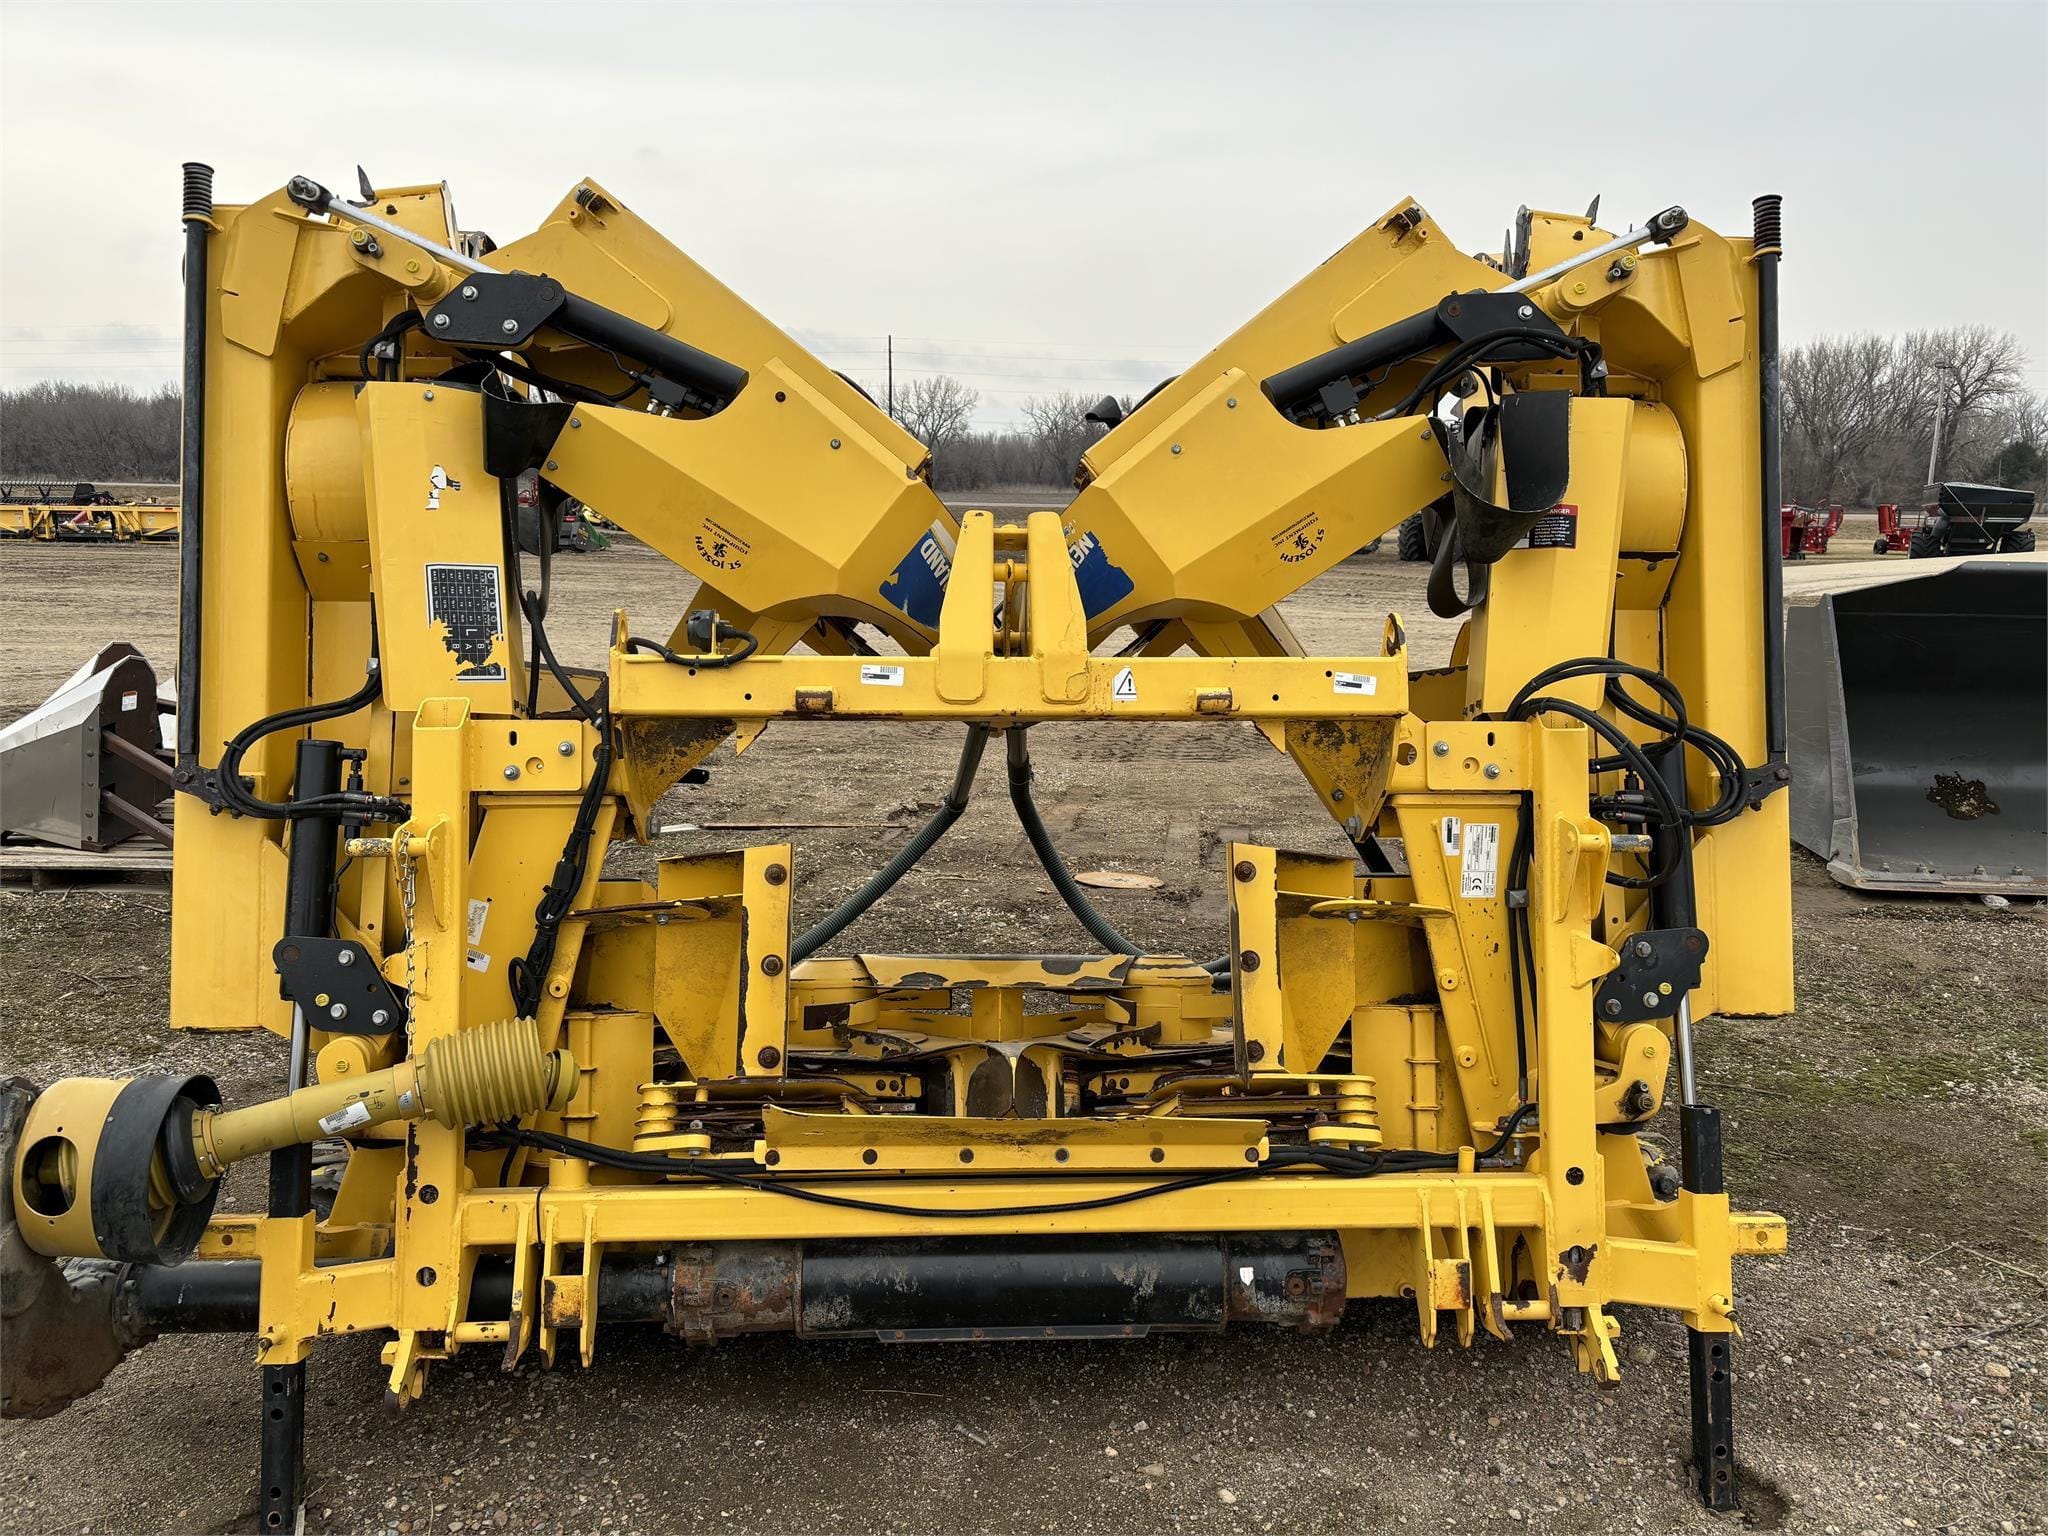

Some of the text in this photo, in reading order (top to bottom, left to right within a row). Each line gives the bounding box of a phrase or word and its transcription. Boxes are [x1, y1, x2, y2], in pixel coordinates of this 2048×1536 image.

[1286, 517, 1319, 541] EQUIPMENT
[695, 536, 725, 569] JOSEPH
[713, 531, 749, 555] EQUIPMENT
[1280, 543, 1317, 563] JOSEPH
